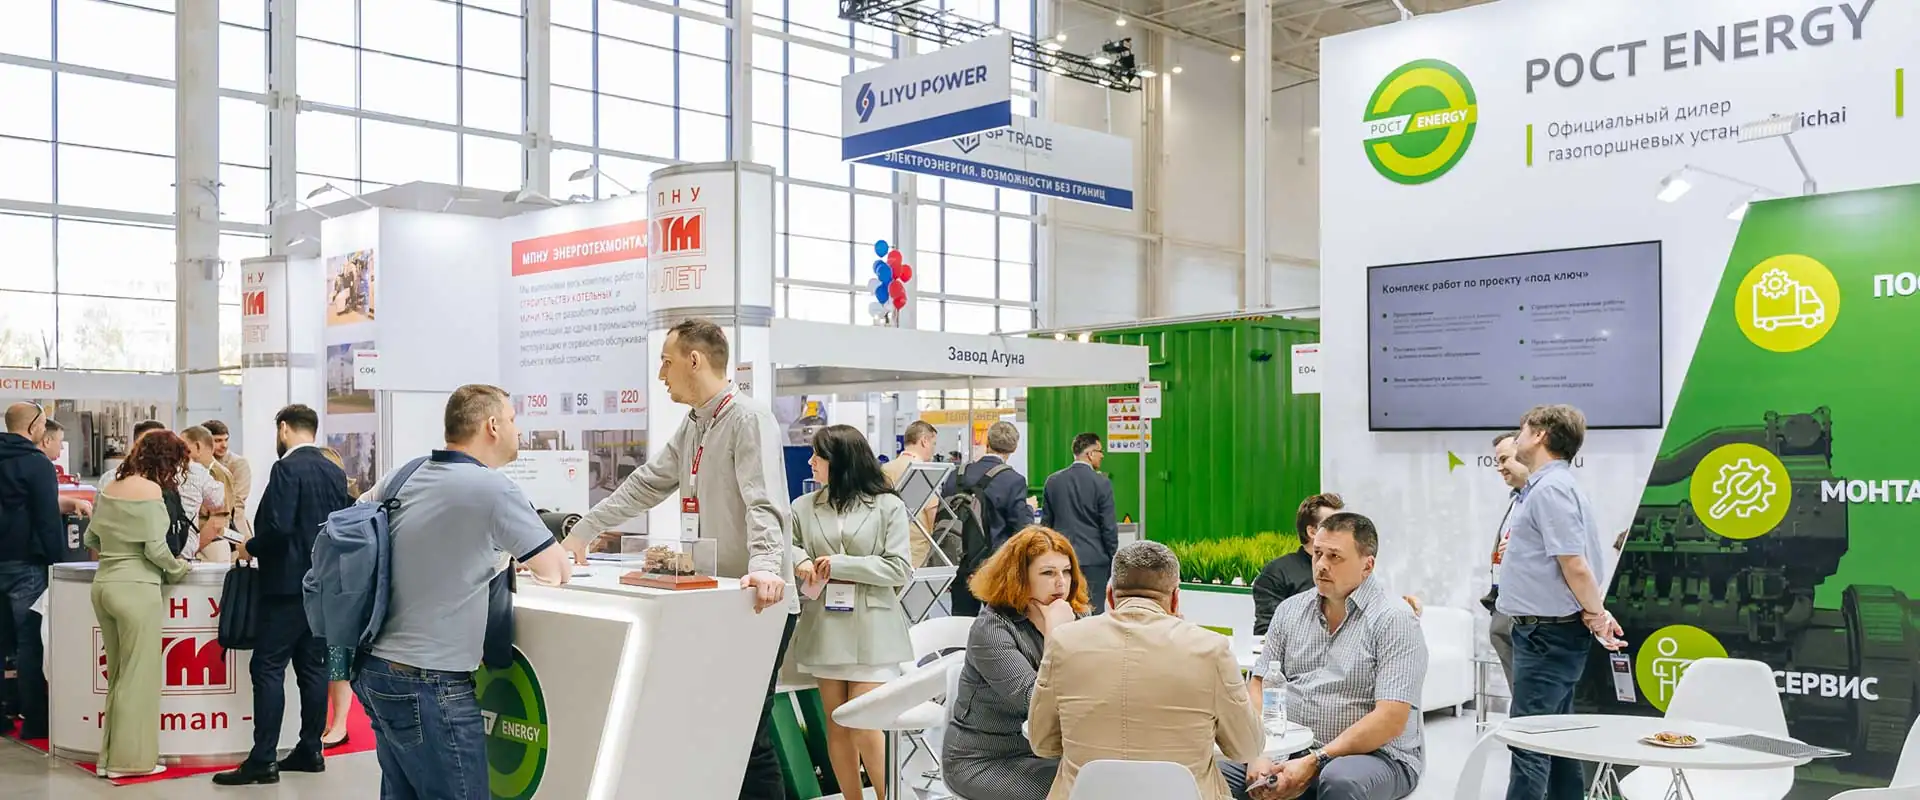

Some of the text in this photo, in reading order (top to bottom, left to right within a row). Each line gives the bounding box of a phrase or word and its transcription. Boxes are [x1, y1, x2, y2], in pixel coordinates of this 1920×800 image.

[1663, 0, 1877, 71] ENERGY
[880, 64, 987, 107] LIYU POWER
[1416, 108, 1469, 129] ENERGY
[1547, 99, 1732, 139] Официальный дилер
[1006, 129, 1053, 151] TRADE
[1548, 106, 1846, 162] газопоршневых устан ichai
[884, 151, 1106, 201] ЭЛЕКТРОЭНЕРГИЯ. ВОЗМОЖНОСТИ БЕЗ ГРАНИЦ
[522, 250, 549, 265] МПНУ
[1382, 270, 1589, 294] Комплекс работ по проекту «под ключ»
[1872, 271, 1920, 298] ПО
[948, 346, 1025, 367] Завод Агуна
[1298, 366, 1317, 374] E04
[527, 394, 548, 408] 7500
[576, 393, 588, 406] 56
[621, 389, 639, 403] 220
[1772, 670, 1880, 701] СЕРВИС
[502, 719, 541, 743] ENERGY
